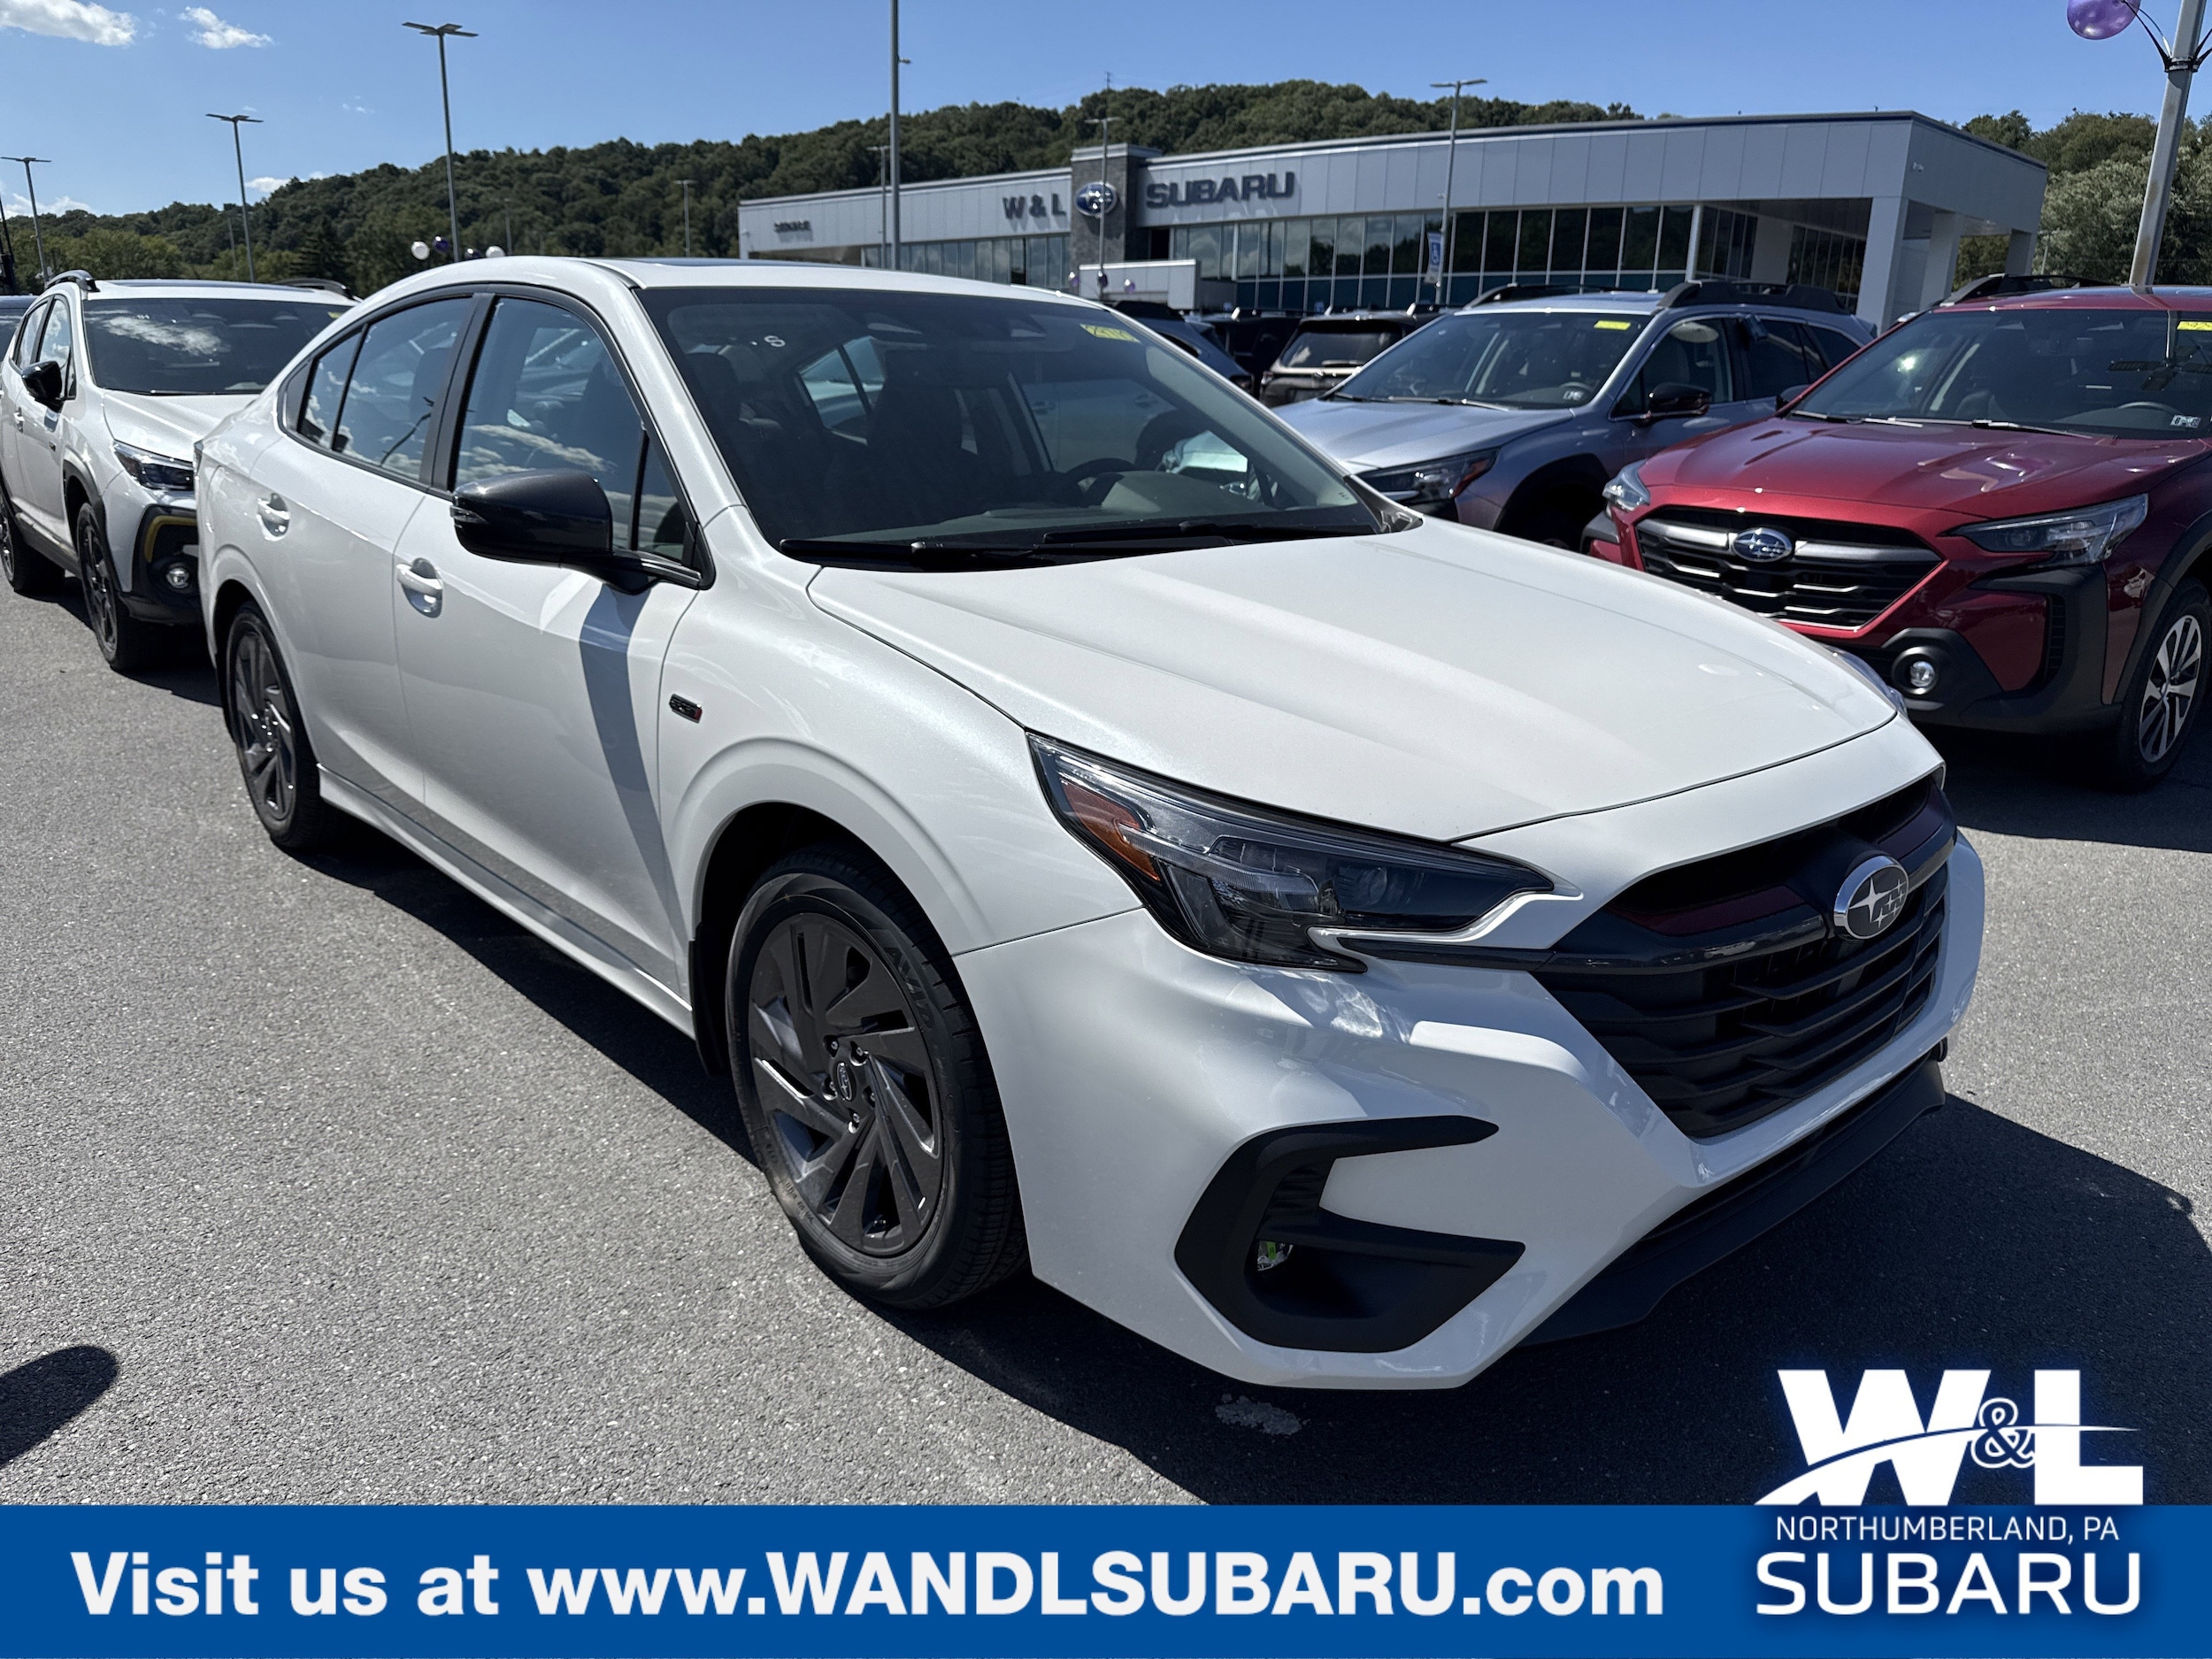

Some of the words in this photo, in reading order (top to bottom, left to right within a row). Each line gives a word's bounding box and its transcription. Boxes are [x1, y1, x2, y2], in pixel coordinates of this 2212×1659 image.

[1145, 172, 1294, 209] SUBARU
[1002, 196, 1025, 219] W
[1029, 195, 1047, 219] &
[1050, 194, 1067, 217] L
